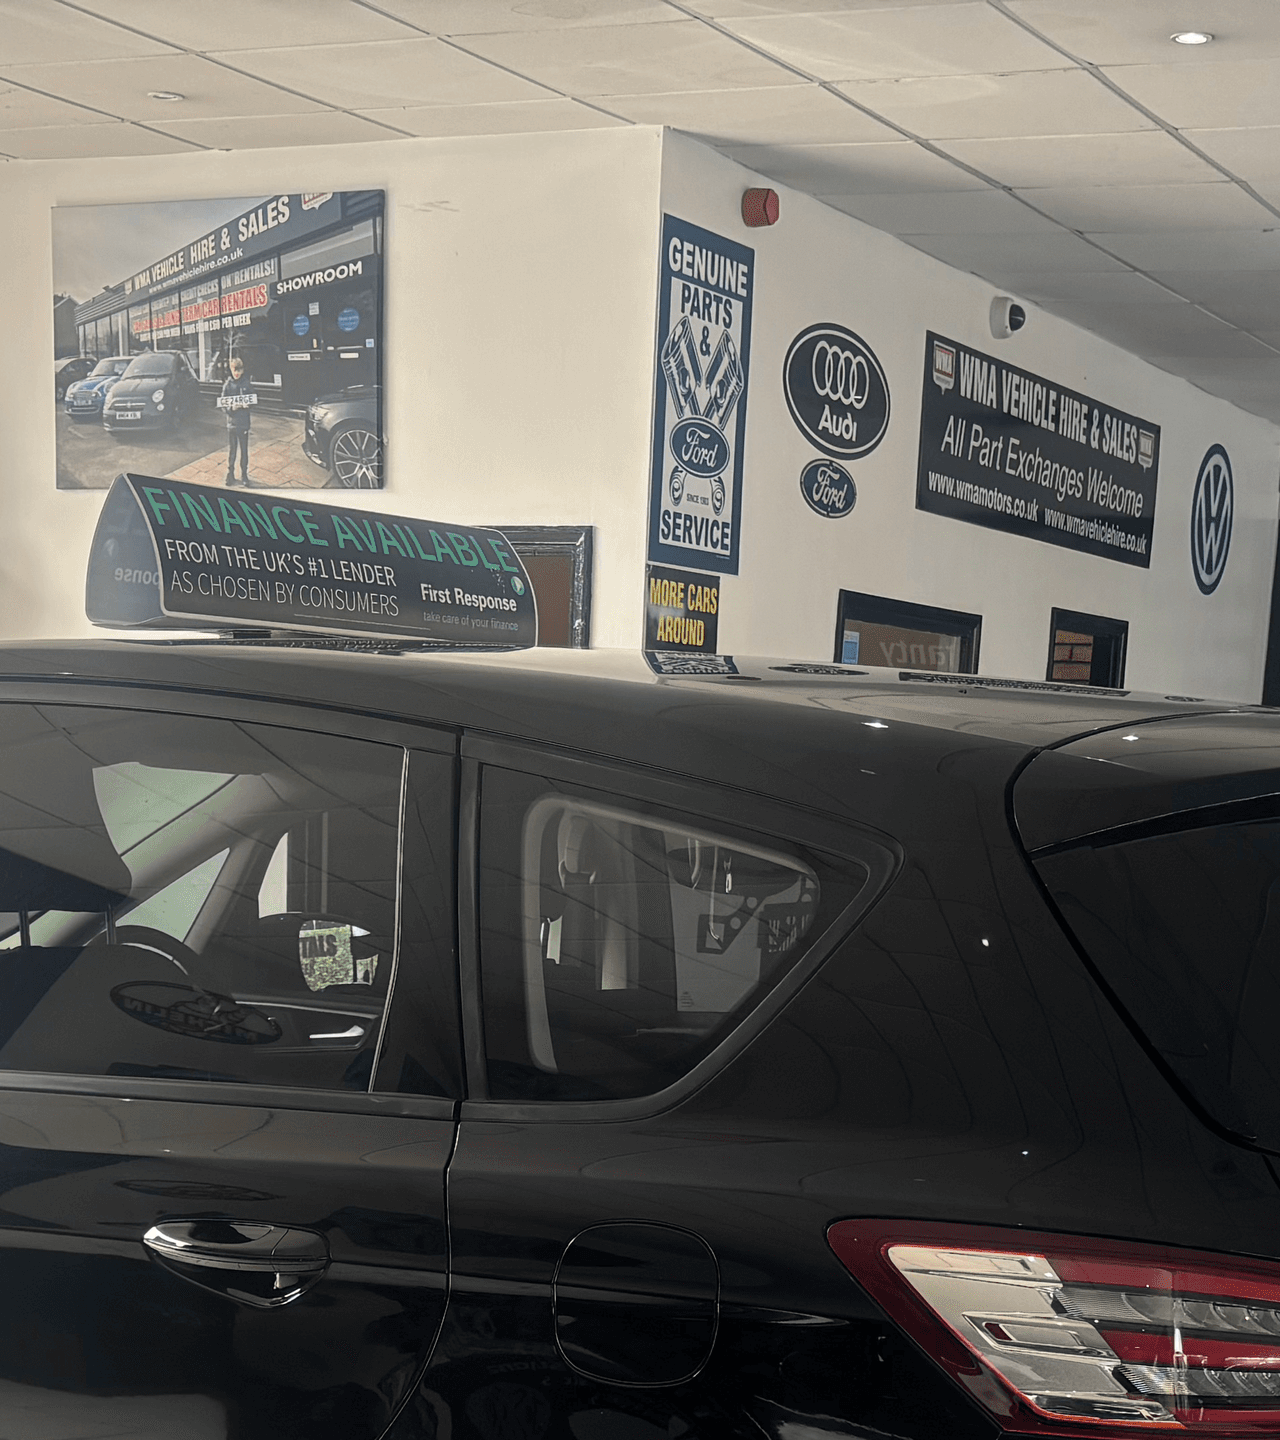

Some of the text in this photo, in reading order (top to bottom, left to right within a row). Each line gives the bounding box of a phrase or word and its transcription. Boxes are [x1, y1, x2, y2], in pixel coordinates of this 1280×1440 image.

[151, 251, 184, 283] VEHICLE
[190, 234, 216, 265] HIRE
[221, 227, 231, 251] &
[238, 195, 290, 242] SALES
[221, 272, 232, 290] ON
[234, 258, 275, 286] RENTALS!
[276, 260, 363, 294] SHOWROOM
[668, 237, 749, 297] GENUINE
[220, 284, 268, 315] RENTALS
[233, 312, 251, 327] WEEK
[680, 282, 733, 329] PARTS
[699, 326, 711, 357] &
[818, 404, 858, 442] Audi
[959, 351, 1138, 464] WMA VEHICLE HIRE & SALES
[681, 427, 719, 468] Ford
[940, 414, 1143, 518] All Part Exchanges Welcome
[812, 466, 848, 509] Ford
[141, 486, 519, 573] FINANCE AVAILABLE
[661, 509, 731, 552] SERVICE
[928, 470, 1148, 555] www.wmamotors.co.uk www.wmavehiclehire.co.uk
[164, 538, 397, 587] FROM THE UK'S #1 LENDER
[171, 570, 399, 617] AS CHOSEN BY CONSUMERS
[420, 583, 518, 612] First Response
[650, 577, 718, 615] MORE CARS
[423, 611, 519, 631] take care of your finance
[656, 615, 705, 647] AROUND
